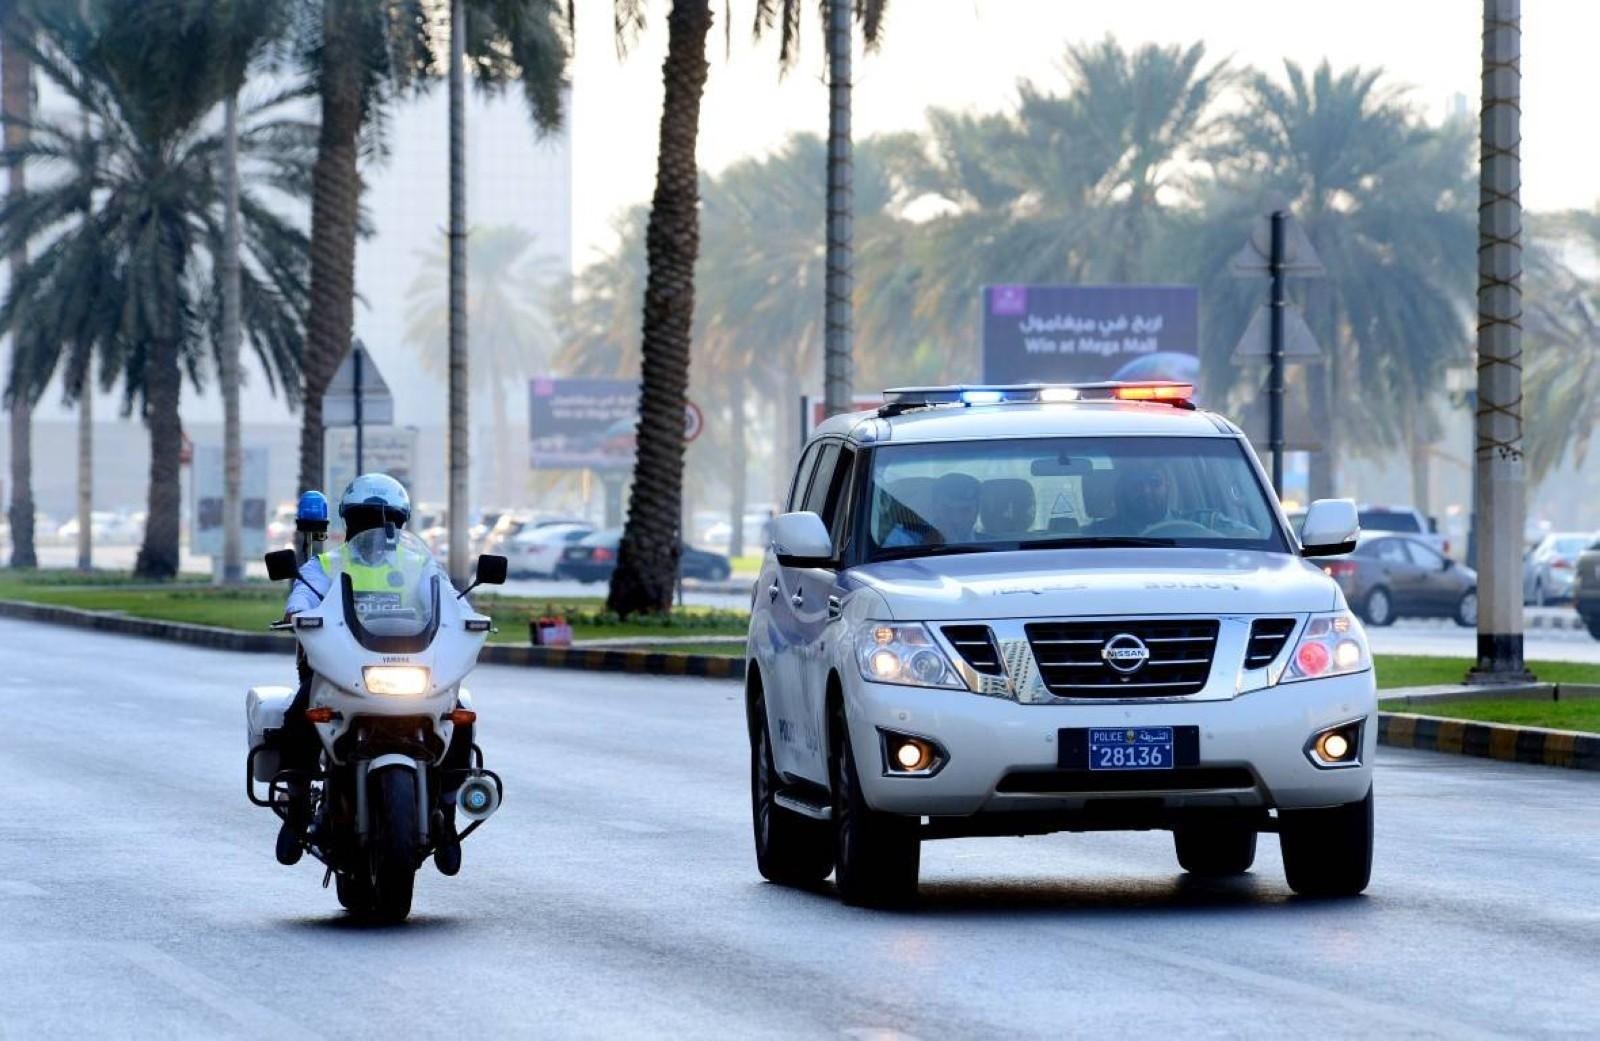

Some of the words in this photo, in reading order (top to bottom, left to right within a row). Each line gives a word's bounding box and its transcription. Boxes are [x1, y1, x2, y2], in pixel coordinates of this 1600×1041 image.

[1099, 314, 1128, 338] في
[1024, 338, 1057, 354] Win
[1059, 340, 1076, 353] at
[1078, 338, 1120, 356] Mega
[1123, 338, 1158, 353] Mall
[353, 602, 401, 613] OLICE
[1093, 731, 1124, 742] POLICE
[1140, 730, 1169, 742] الشرطة
[1100, 746, 1162, 766] 28136
